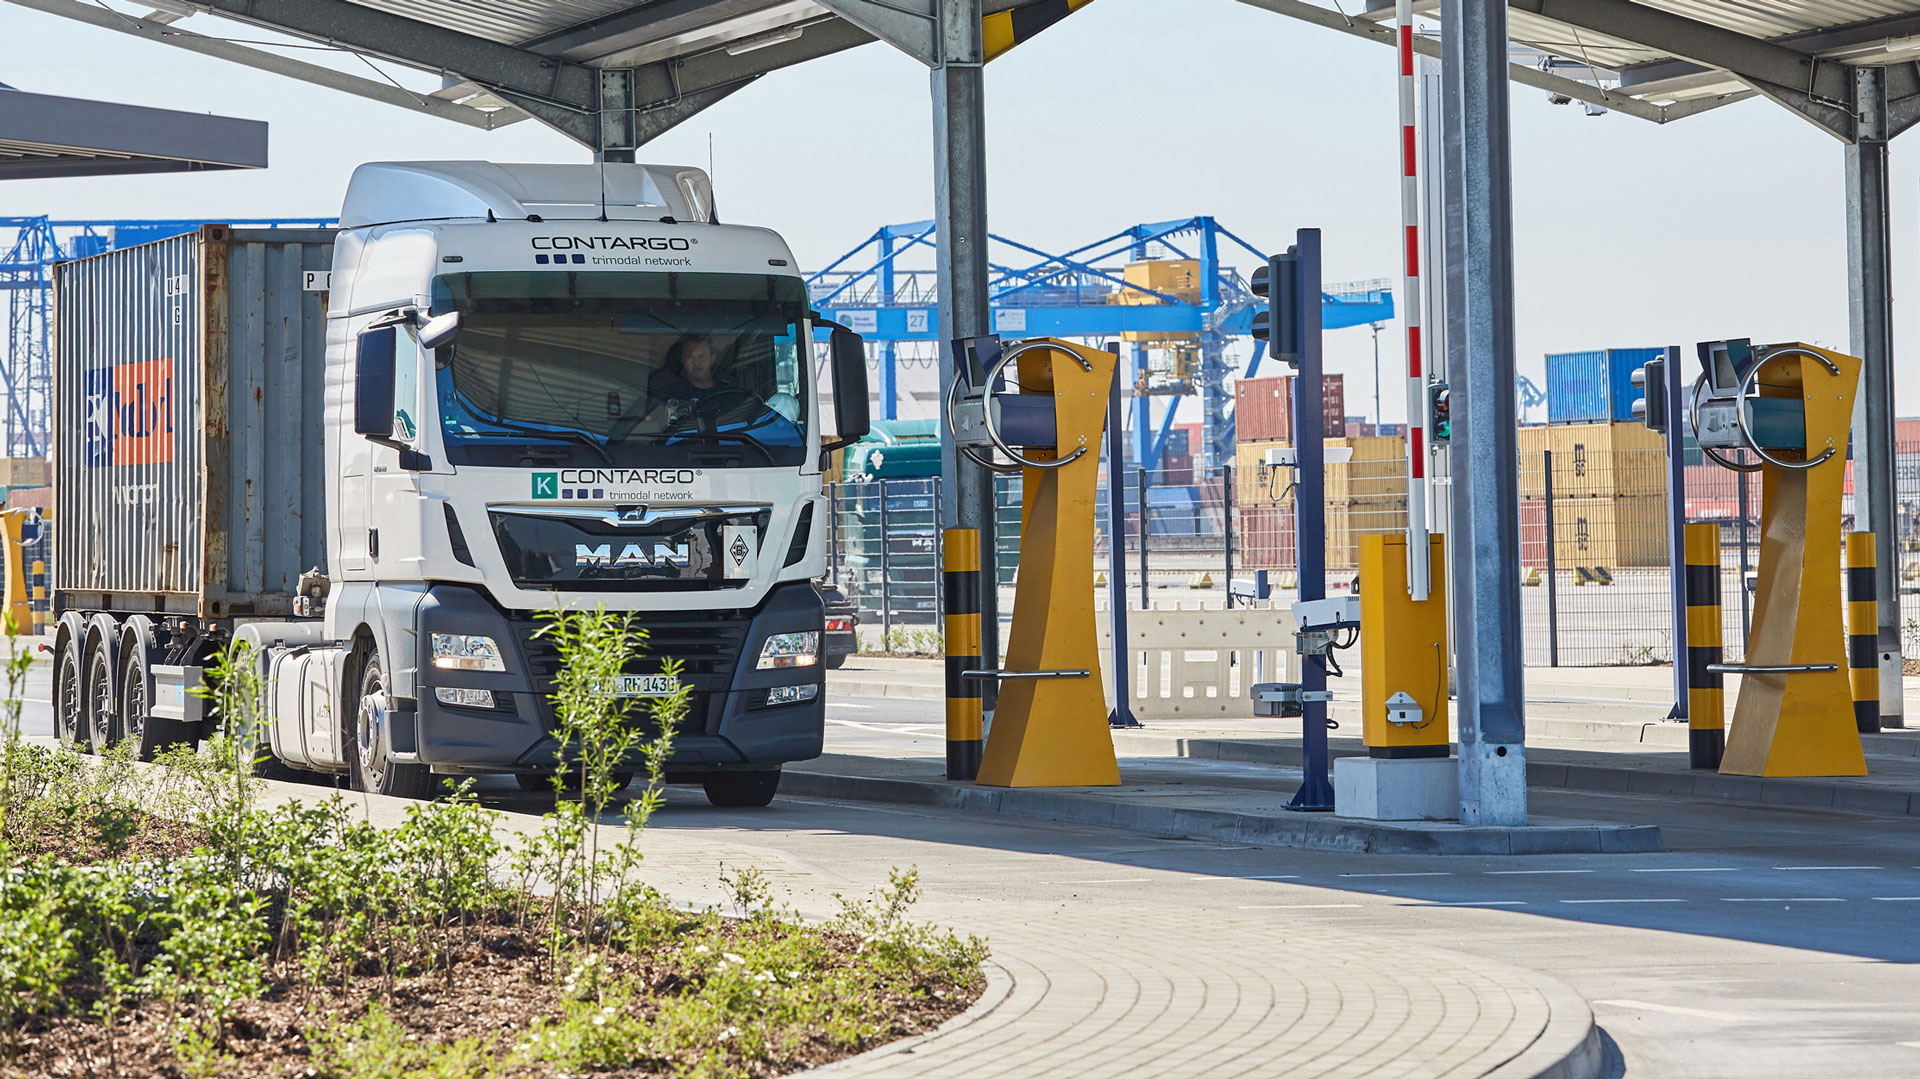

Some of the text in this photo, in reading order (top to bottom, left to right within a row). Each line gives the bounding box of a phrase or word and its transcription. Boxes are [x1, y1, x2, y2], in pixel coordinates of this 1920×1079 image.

[592, 255, 692, 266] trimodal network
[909, 315, 925, 327] 27
[536, 476, 552, 495] K
[609, 490, 693, 500] trimodal network
[575, 543, 689, 567] MAN
